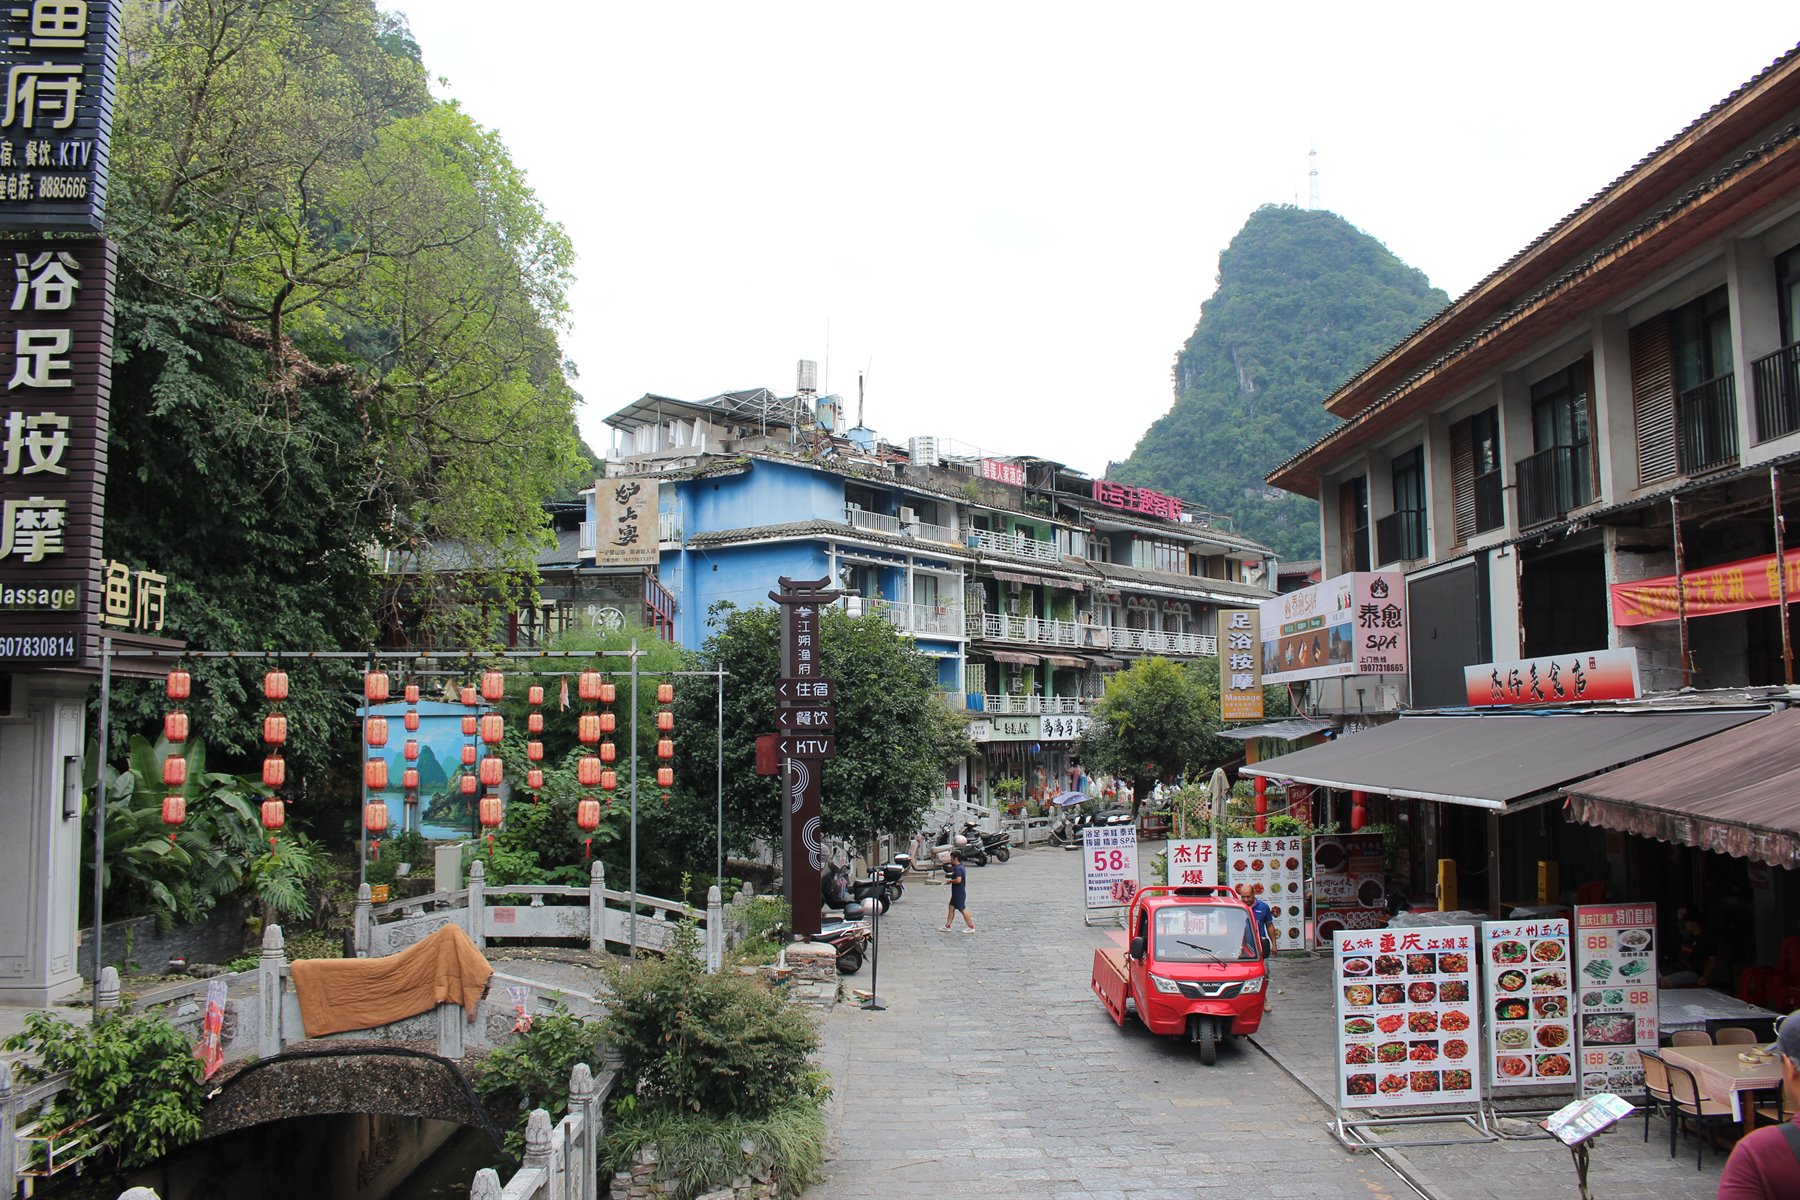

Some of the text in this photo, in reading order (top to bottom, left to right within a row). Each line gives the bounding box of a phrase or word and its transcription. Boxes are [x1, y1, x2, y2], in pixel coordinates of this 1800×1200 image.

[0, 251, 80, 563] 浴足按摩
[0, 583, 76, 609] assage
[1358, 602, 1402, 629] 泰愈
[797, 620, 811, 675] 江朔渔府
[1365, 634, 1398, 652] SPA
[1228, 612, 1254, 691] 足浴按摩
[1490, 659, 1587, 702] 杰仔美食店
[796, 682, 829, 697] 住宿
[1224, 693, 1261, 703] Massage
[796, 711, 829, 726] 餐饮
[796, 740, 829, 754] KTV
[1120, 828, 1135, 837] 泰式
[1120, 837, 1136, 845] SPA
[1233, 839, 1300, 853] 杰仔美食店
[1094, 850, 1124, 871] 58
[1173, 844, 1213, 864] 杰仔
[1181, 870, 1204, 885] 爆
[1616, 908, 1653, 924] 特价套餐
[1587, 936, 1608, 949] 68
[1629, 991, 1649, 1004] 98
[1637, 1017, 1656, 1027] 万州
[1583, 1053, 1604, 1064] 158
